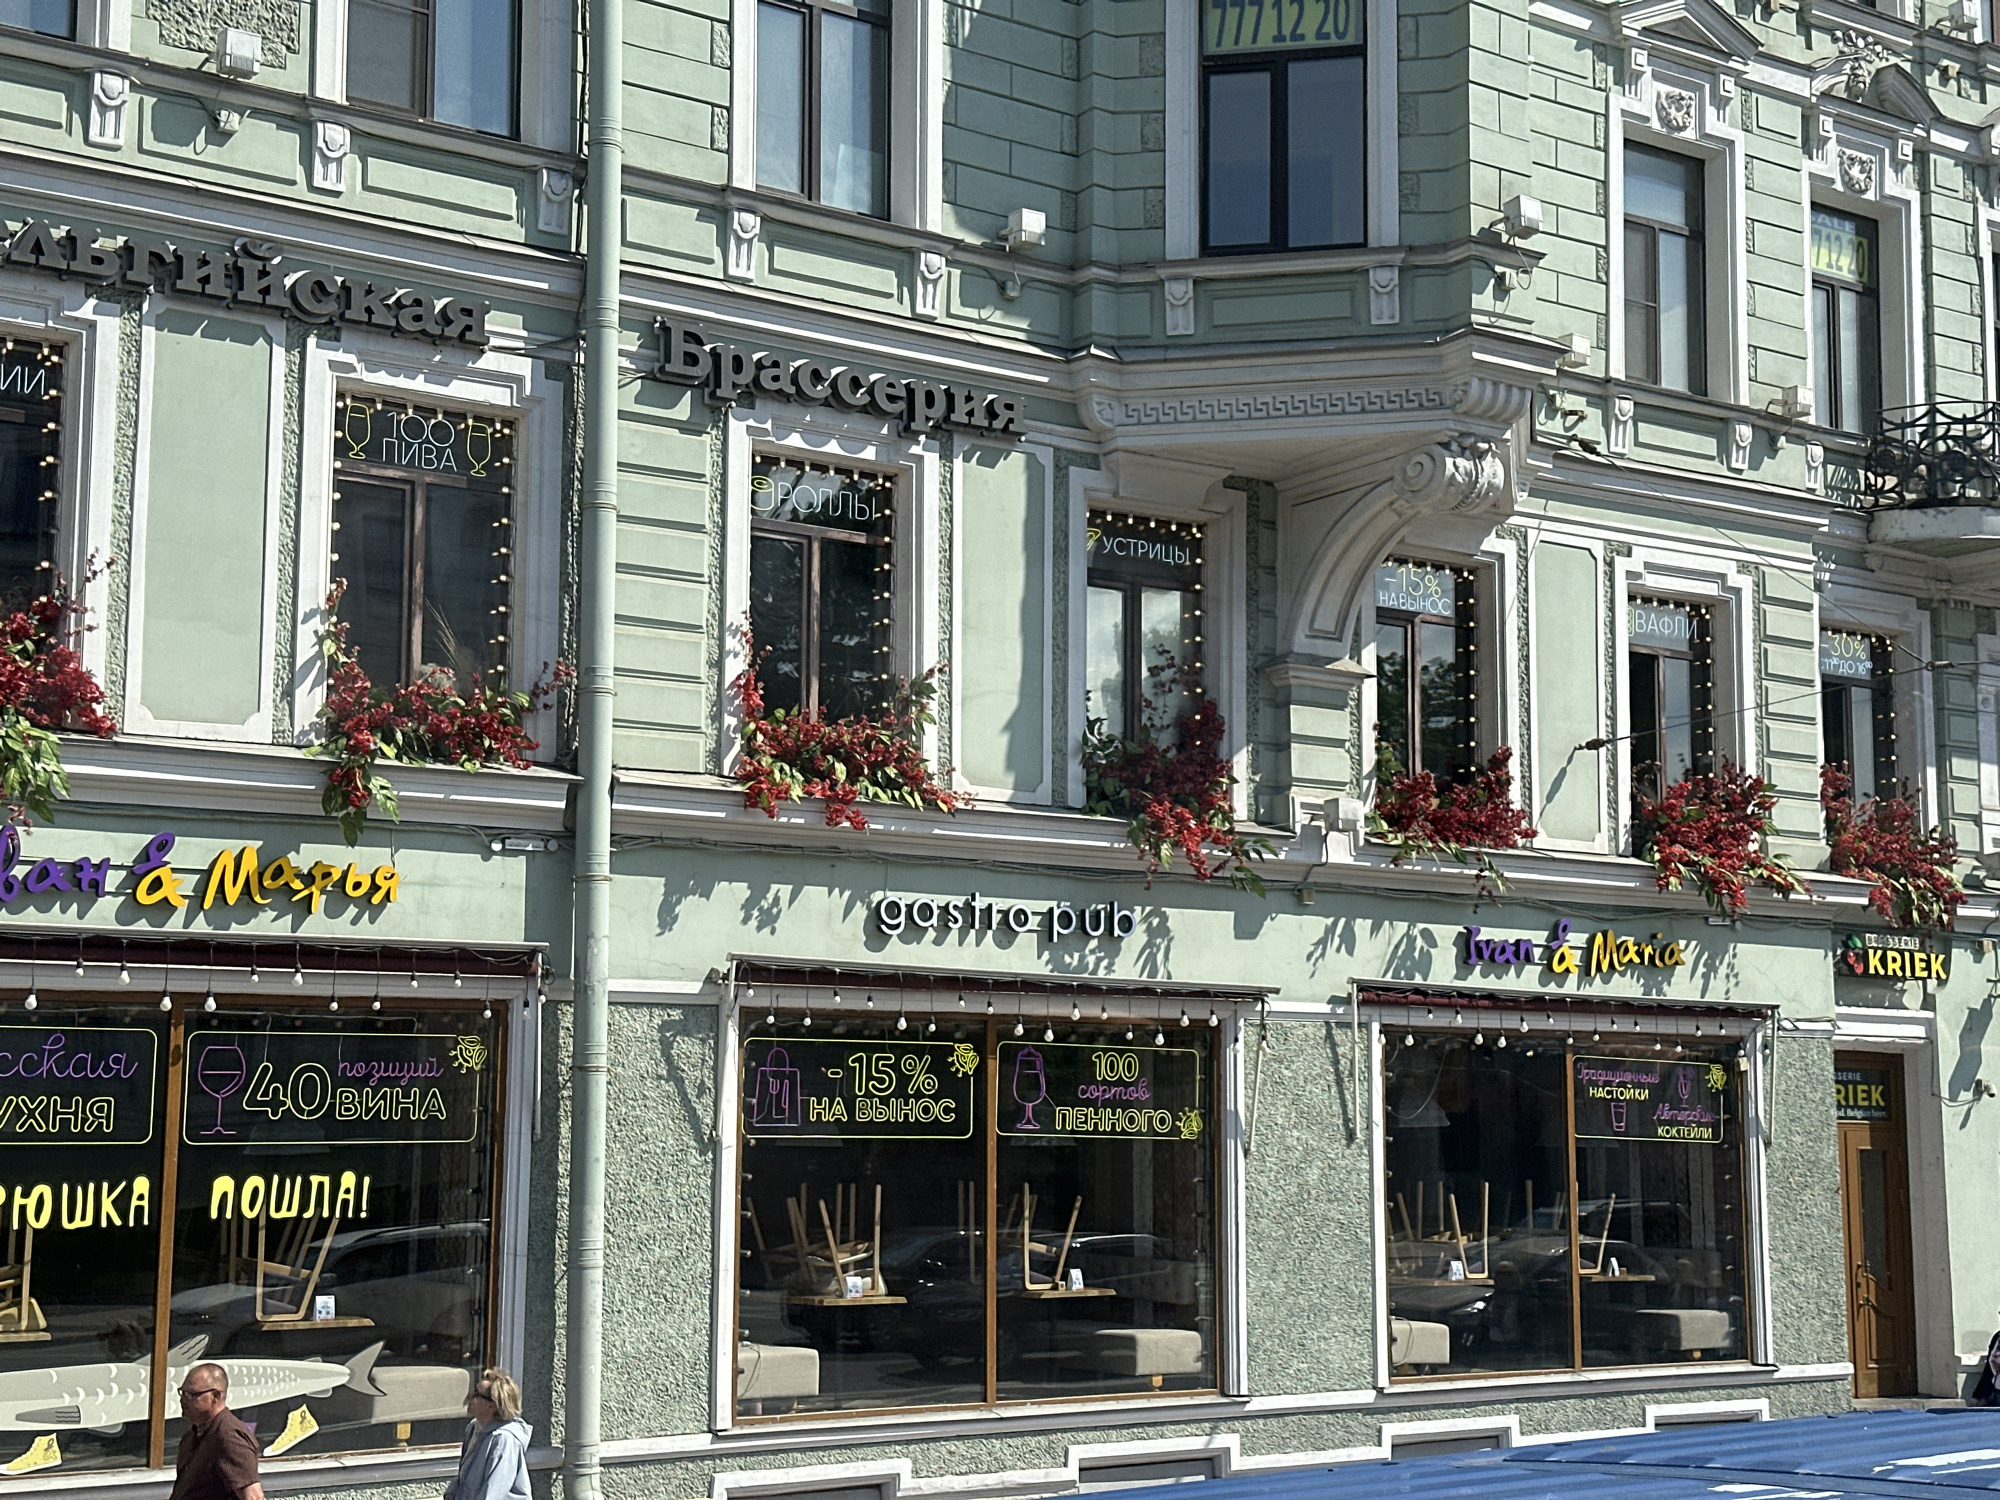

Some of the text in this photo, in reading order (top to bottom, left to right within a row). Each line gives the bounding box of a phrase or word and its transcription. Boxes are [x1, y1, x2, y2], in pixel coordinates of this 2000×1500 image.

[1211, 0, 1351, 48] 777 12 20
[1825, 231, 1843, 273] 12
[1847, 236, 1866, 280] 20
[658, 320, 1028, 434] Брассерия
[386, 411, 456, 447] 100
[382, 437, 458, 472] ПИВА
[777, 481, 876, 522] РОЛЛЫ
[1101, 535, 1191, 566] УСТРИЦЫ
[1384, 567, 1442, 598] -15%
[1635, 609, 1698, 640] ВАФЛИ
[1820, 633, 1867, 660] -30%
[203, 845, 401, 915] Марья
[878, 892, 1137, 943] gastro pub
[1463, 925, 1535, 966] Ivan
[1590, 929, 1687, 978] Maria
[1868, 948, 1947, 980] KRIEK
[1092, 1051, 1140, 1082] 100
[242, 1061, 447, 1121] 40 ВИНА
[1077, 1077, 1152, 1107] сортов
[1588, 1083, 1650, 1101] НАСТОЙКИ
[809, 1096, 956, 1123] НА ВЫНОС
[1055, 1106, 1173, 1134] ПЕННОГО
[1656, 1122, 1713, 1140] КОКТЕЙЛИ
[209, 1170, 371, 1220] ПОШЛА!
